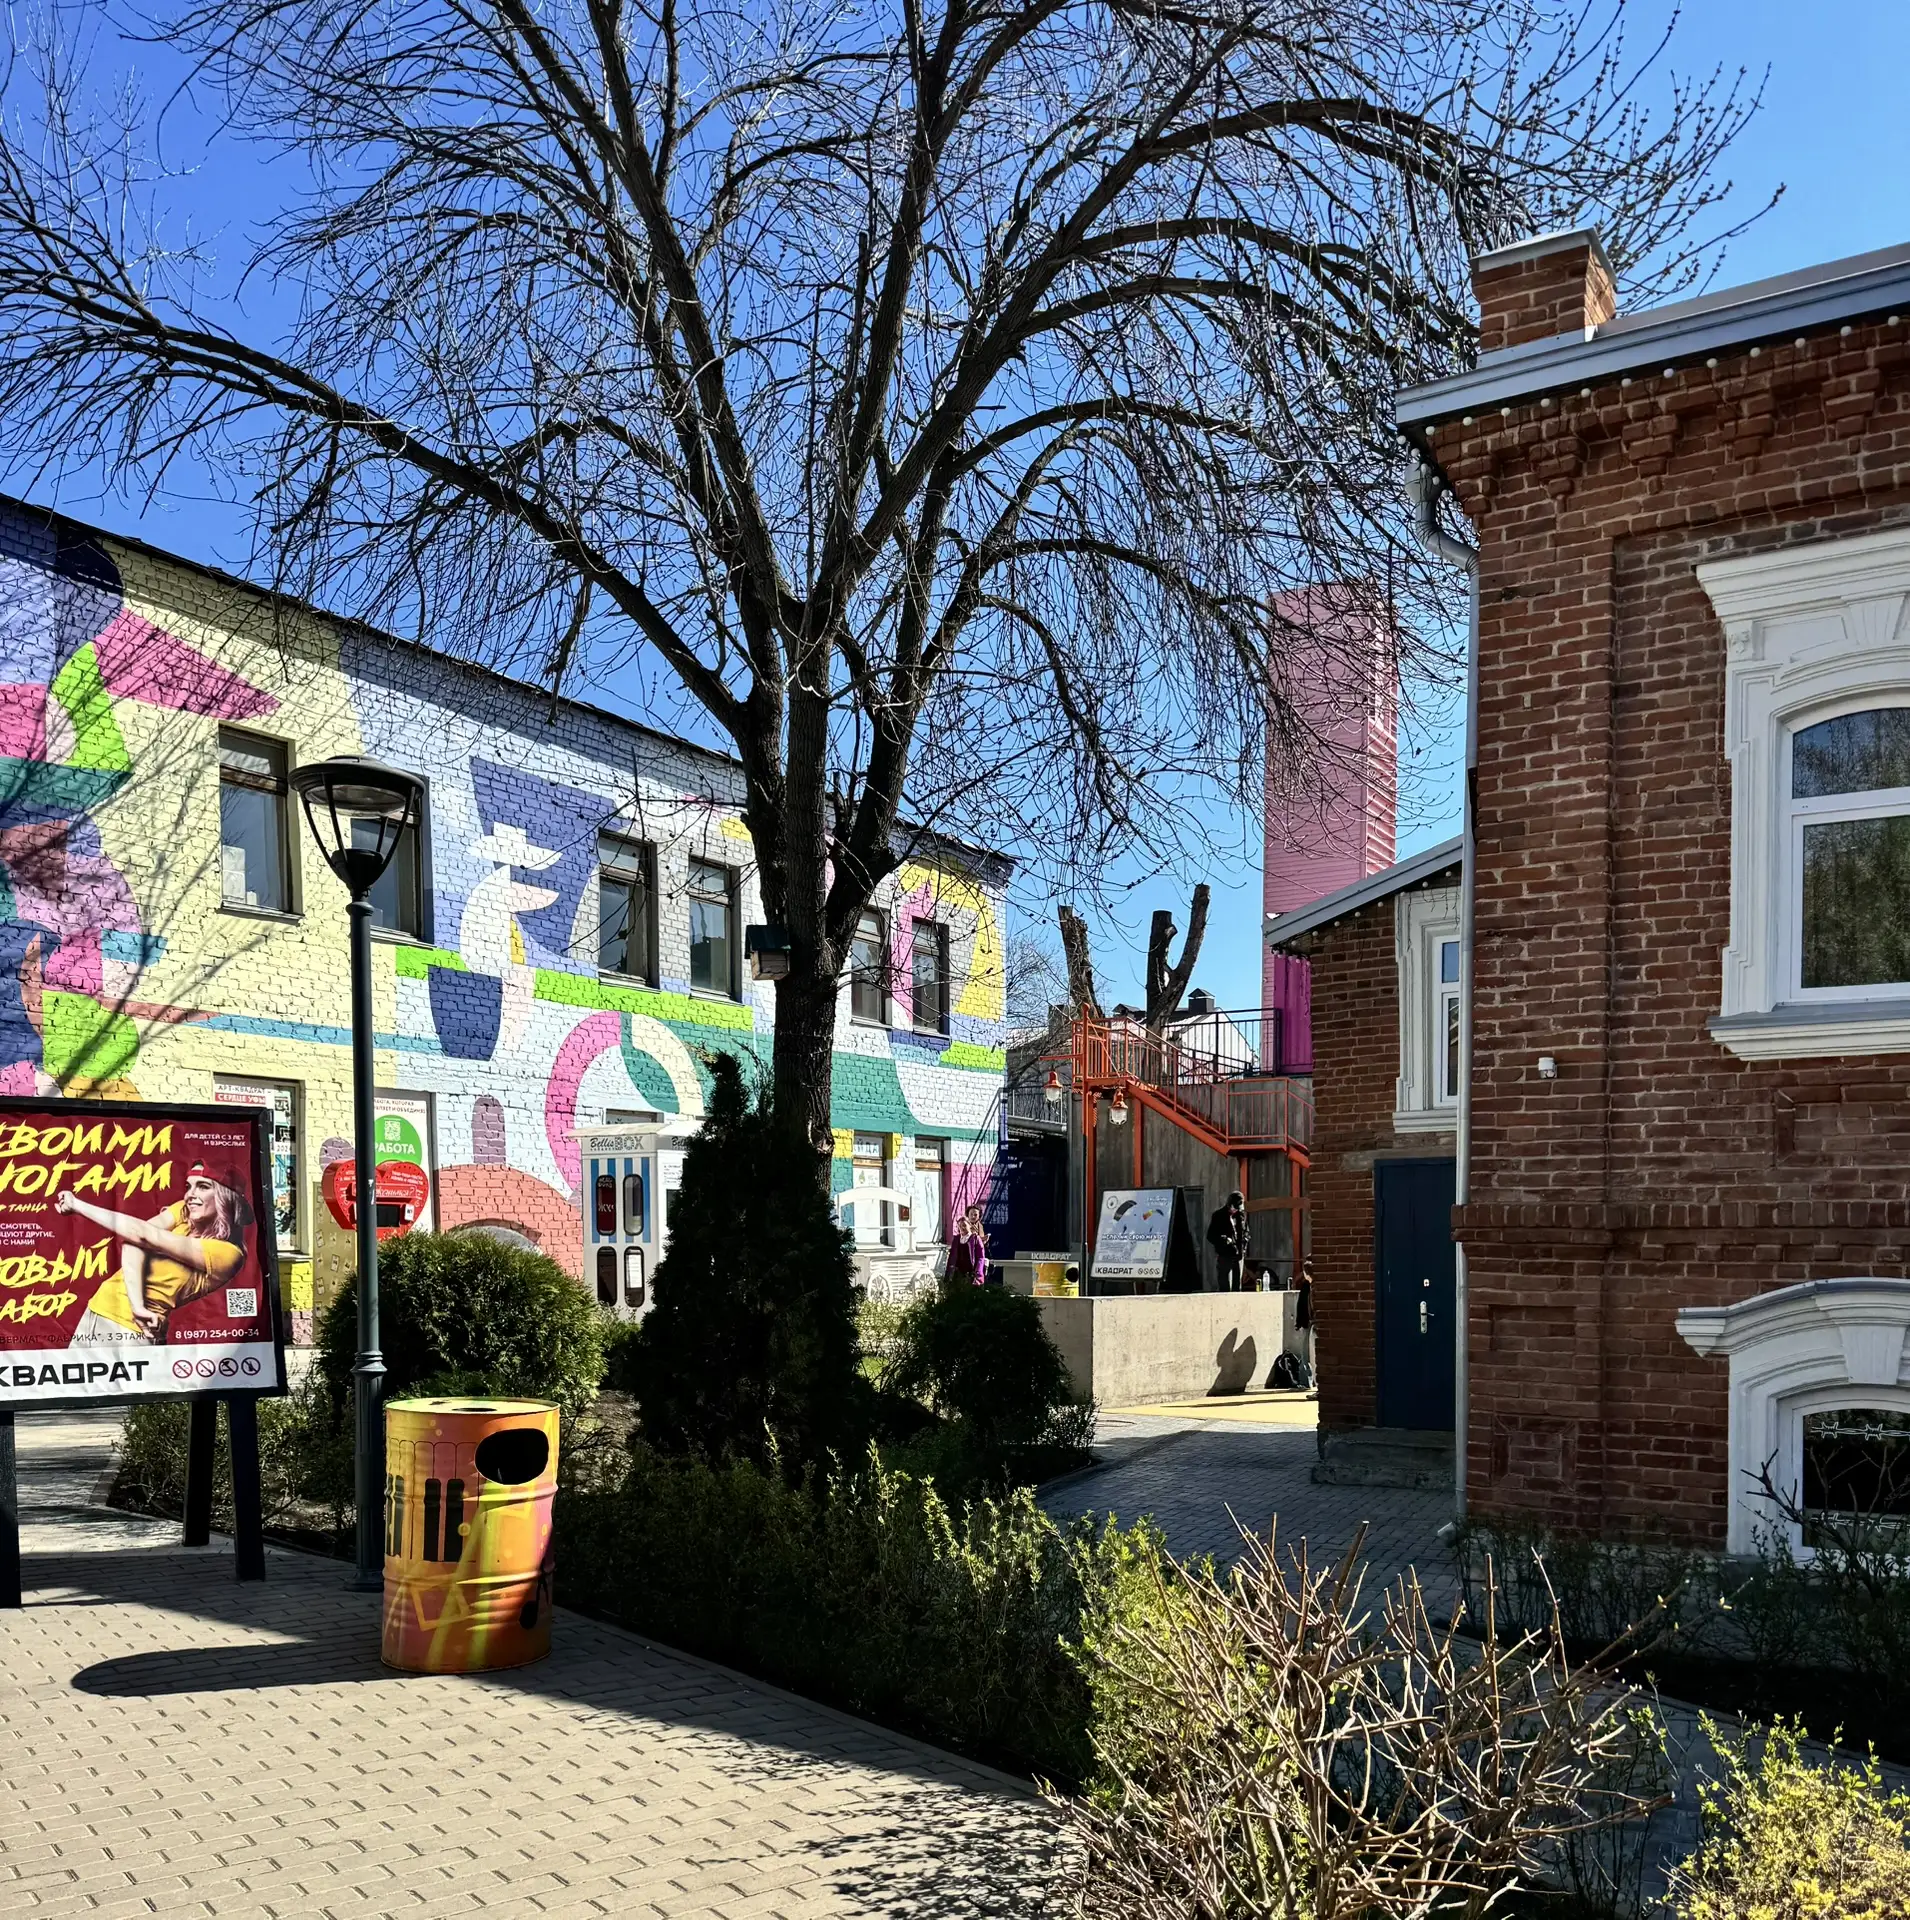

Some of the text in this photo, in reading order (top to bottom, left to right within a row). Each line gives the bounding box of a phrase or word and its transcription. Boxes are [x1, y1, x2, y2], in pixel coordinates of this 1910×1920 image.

[9, 1202, 48, 1213] ТАНЦА
[0, 1231, 24, 1239] ЦУЮТ
[0, 1236, 114, 1288] ОВЫЙ
[0, 1288, 78, 1324] АБОР
[107, 1333, 114, 1341] 3
[175, 1328, 259, 1340] 8 (987) 254-00-34
